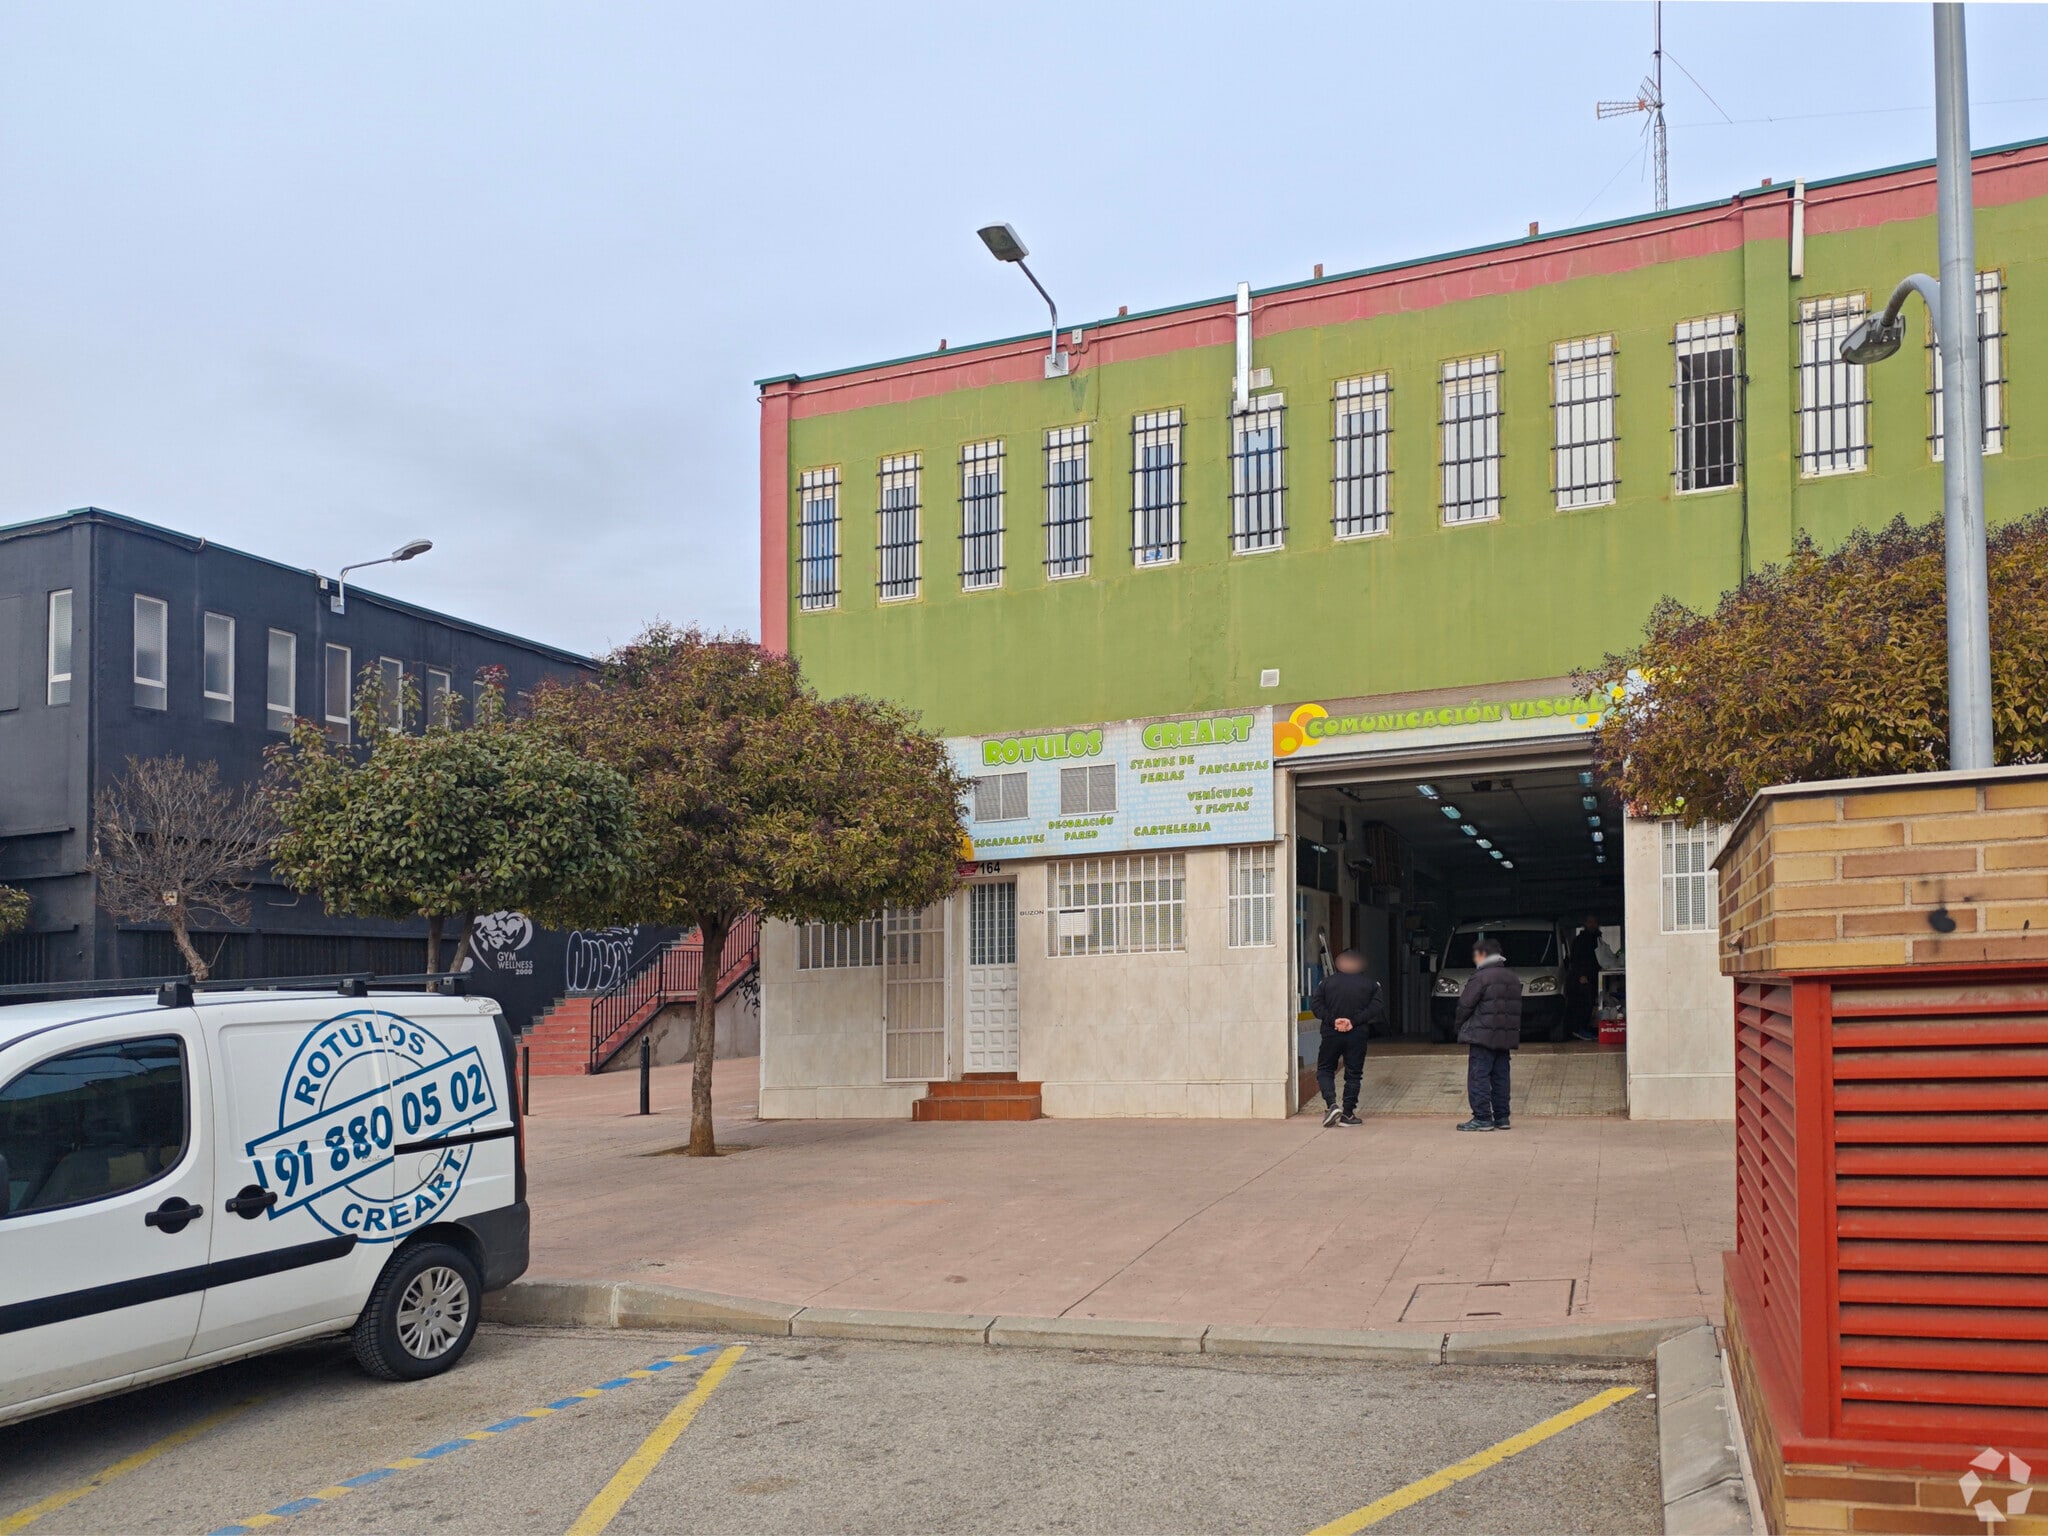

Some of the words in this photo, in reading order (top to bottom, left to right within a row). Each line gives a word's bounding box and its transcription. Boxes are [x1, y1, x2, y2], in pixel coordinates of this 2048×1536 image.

[1305, 699, 1502, 738] COMUNICACIÓN
[1509, 692, 1606, 720] VISUAL
[982, 729, 1103, 767] ROTULOS
[1142, 714, 1254, 750] CREART
[1130, 756, 1175, 770] STANDS
[1178, 755, 1195, 766] DE
[1199, 760, 1269, 775] PANCARTAS
[1140, 770, 1185, 784] FERIAS
[1187, 786, 1253, 801] VEHÍCULOS
[1194, 804, 1204, 814] Y
[1206, 801, 1250, 814] FLOTAS
[1048, 813, 1114, 829] DECORACIÓN
[1134, 821, 1211, 836] CARTELERIA
[974, 834, 1045, 848] ESCAPARATES
[1064, 830, 1099, 841] PARED
[980, 862, 1001, 874] 164
[497, 951, 517, 961] GYM
[497, 960, 533, 969] WELLNESS
[294, 1021, 426, 1106] ROTULOS
[274, 1140, 314, 1197] 91
[325, 1105, 394, 1172] 880
[401, 1082, 442, 1135] 05
[450, 1064, 486, 1112] 02
[341, 1149, 463, 1232] CREART
